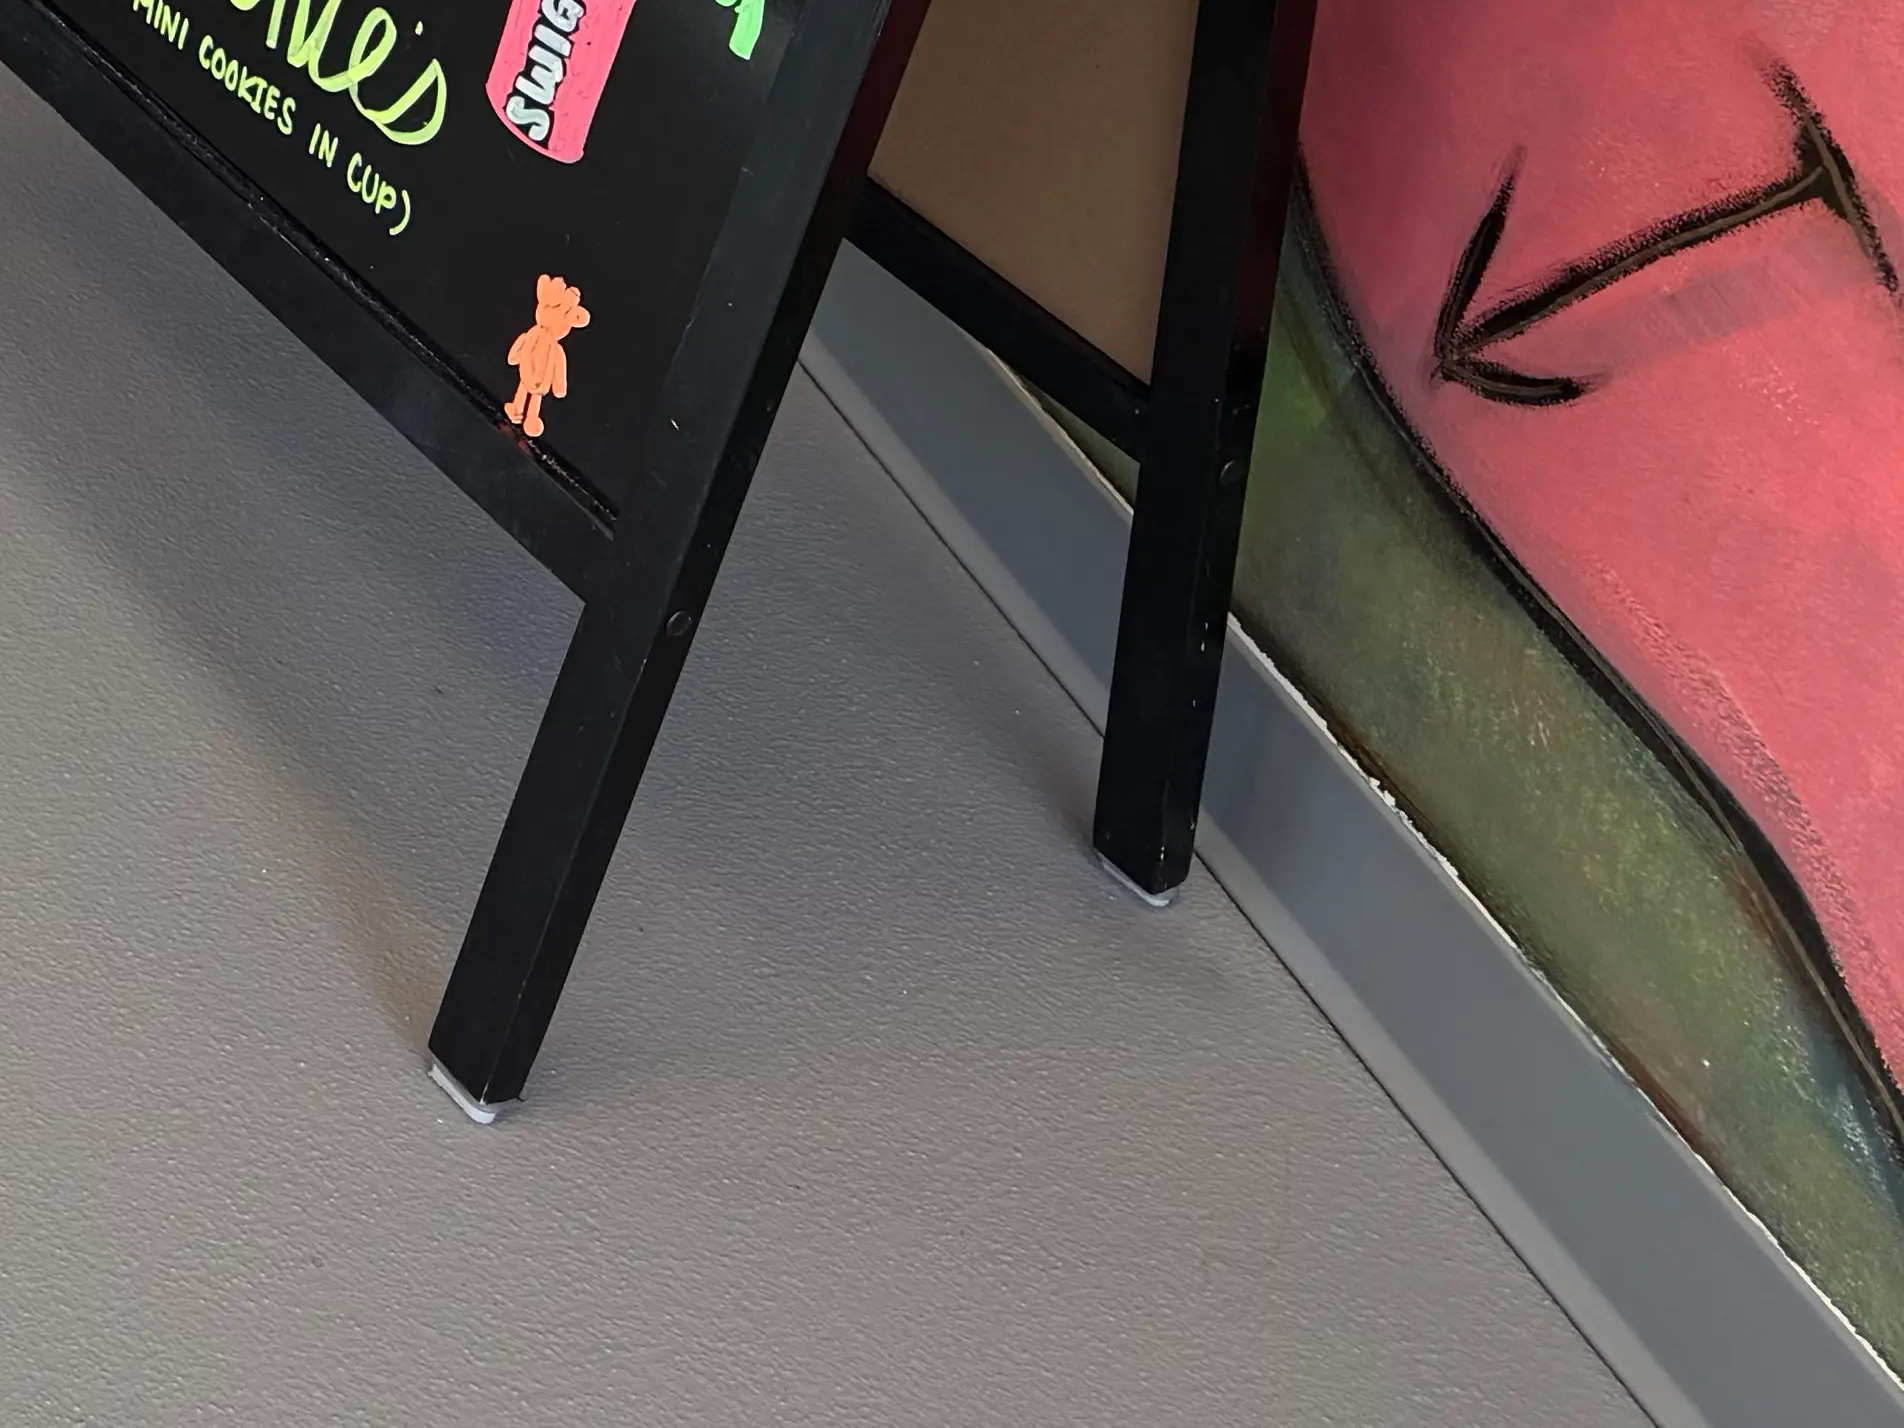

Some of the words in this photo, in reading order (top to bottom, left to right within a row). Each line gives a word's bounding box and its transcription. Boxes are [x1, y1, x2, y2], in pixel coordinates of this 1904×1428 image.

[198, 35, 296, 135] COOKIES
[309, 123, 339, 168] IN
[346, 152, 411, 236] CUP)
